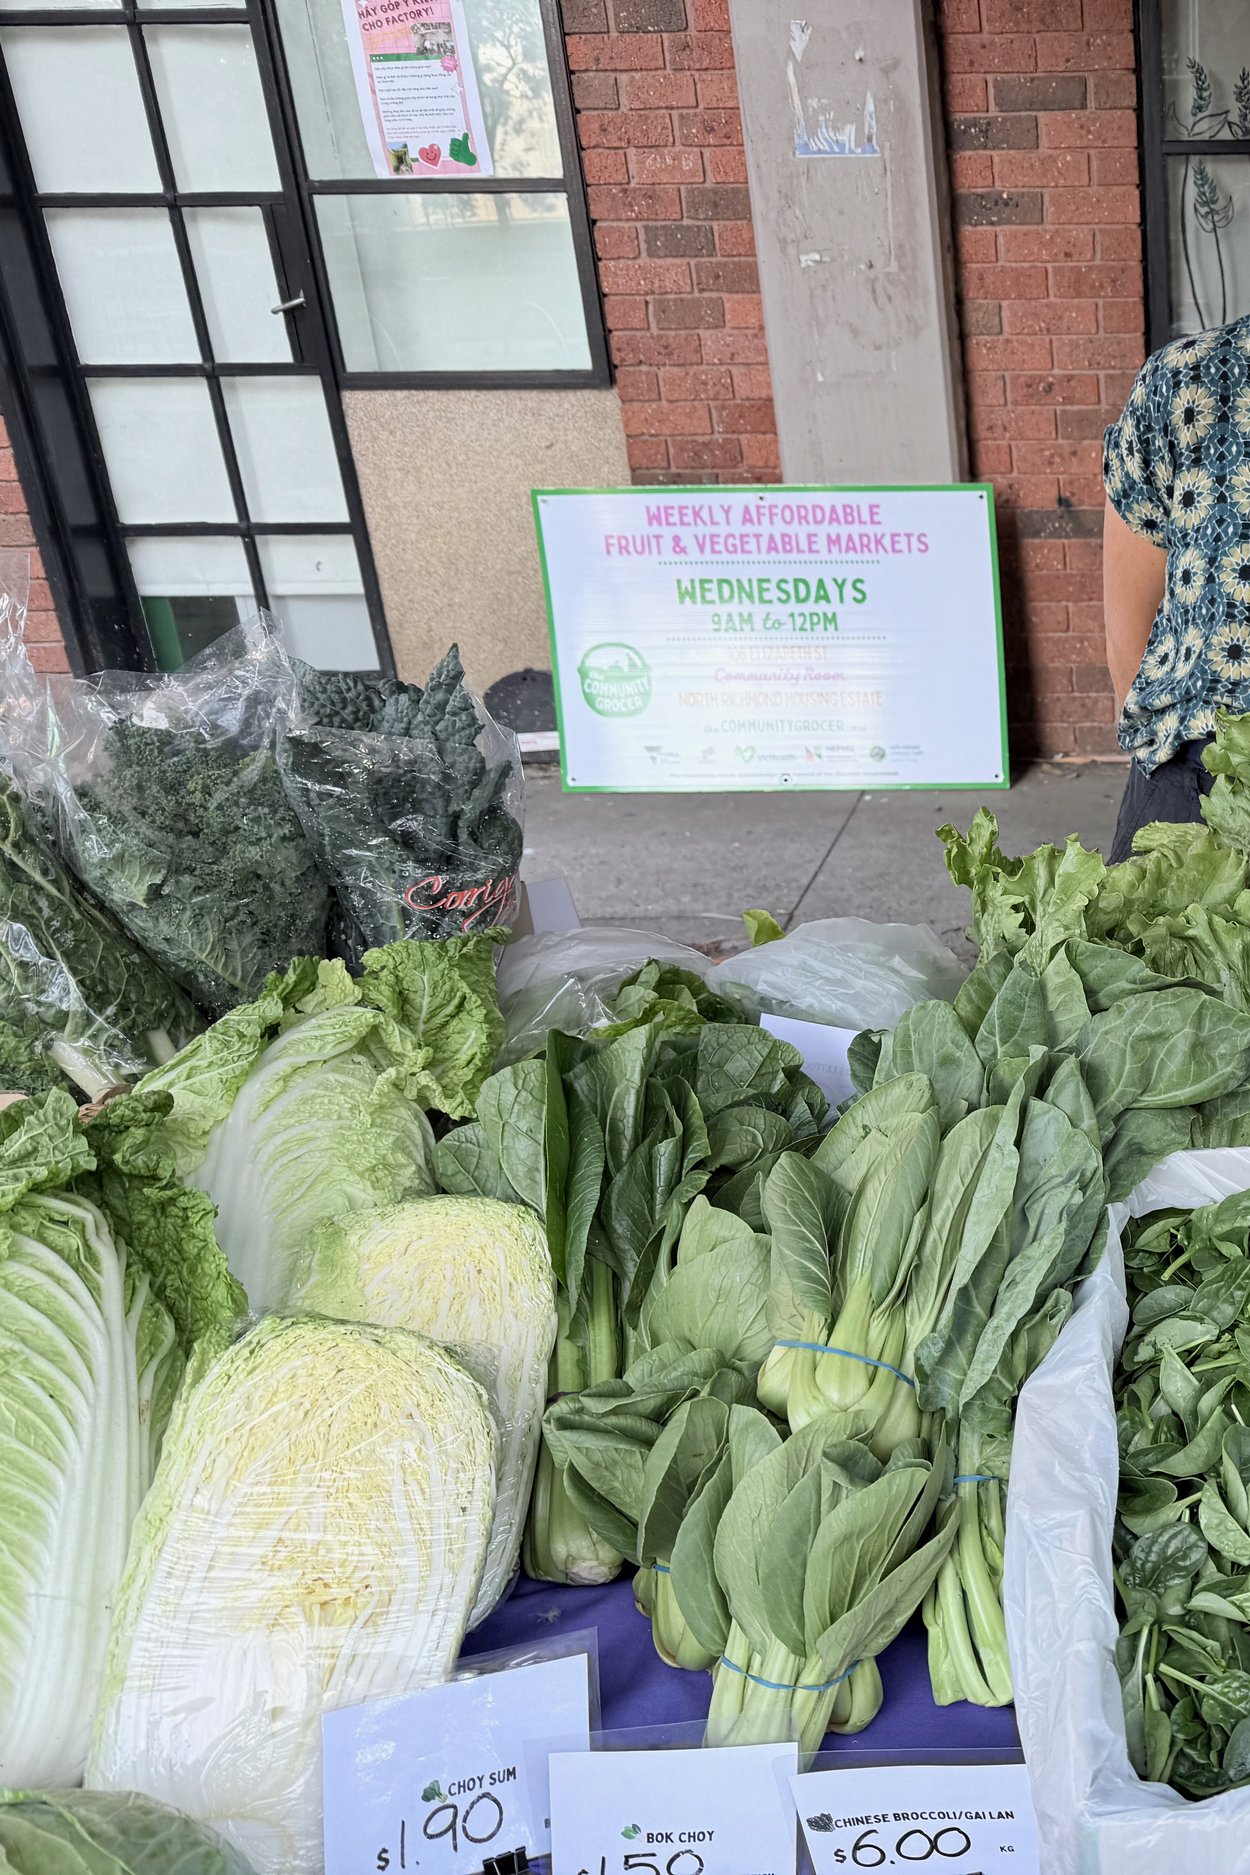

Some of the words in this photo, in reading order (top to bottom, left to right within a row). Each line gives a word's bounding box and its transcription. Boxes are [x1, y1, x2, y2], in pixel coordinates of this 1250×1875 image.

[362, 19, 383, 31] CHO
[385, 6, 434, 26] FACTORY!
[645, 505, 732, 527] WEEKLY
[741, 504, 881, 526] AFFORDABLE
[604, 534, 663, 556] FRUIT
[671, 534, 688, 555] &
[693, 533, 820, 555] VEGETABLE
[827, 532, 929, 554] MARKETS
[676, 578, 867, 605] WEDNESDAYS
[711, 613, 754, 632] 9AM
[762, 612, 787, 631] to
[789, 612, 838, 632] 12PM
[713, 667, 801, 685] Community
[802, 666, 846, 681] Room
[584, 677, 650, 697] COMMUNITY
[595, 696, 644, 712] GROCER
[678, 691, 719, 708] NORTH
[721, 691, 783, 707] RICHMOND
[786, 690, 839, 707] HOUSING
[841, 690, 883, 707] ESTATE
[448, 1775, 485, 1797] CHOY
[489, 1766, 517, 1787] SUM
[834, 1813, 890, 1830] CHINESE
[989, 1810, 1015, 1820] LAN
[376, 1791, 504, 1871] $1.90
[646, 1832, 674, 1844] BOK
[678, 1830, 715, 1844] CHOY
[833, 1826, 971, 1868] $6.00
[1000, 1845, 1015, 1853] KG
